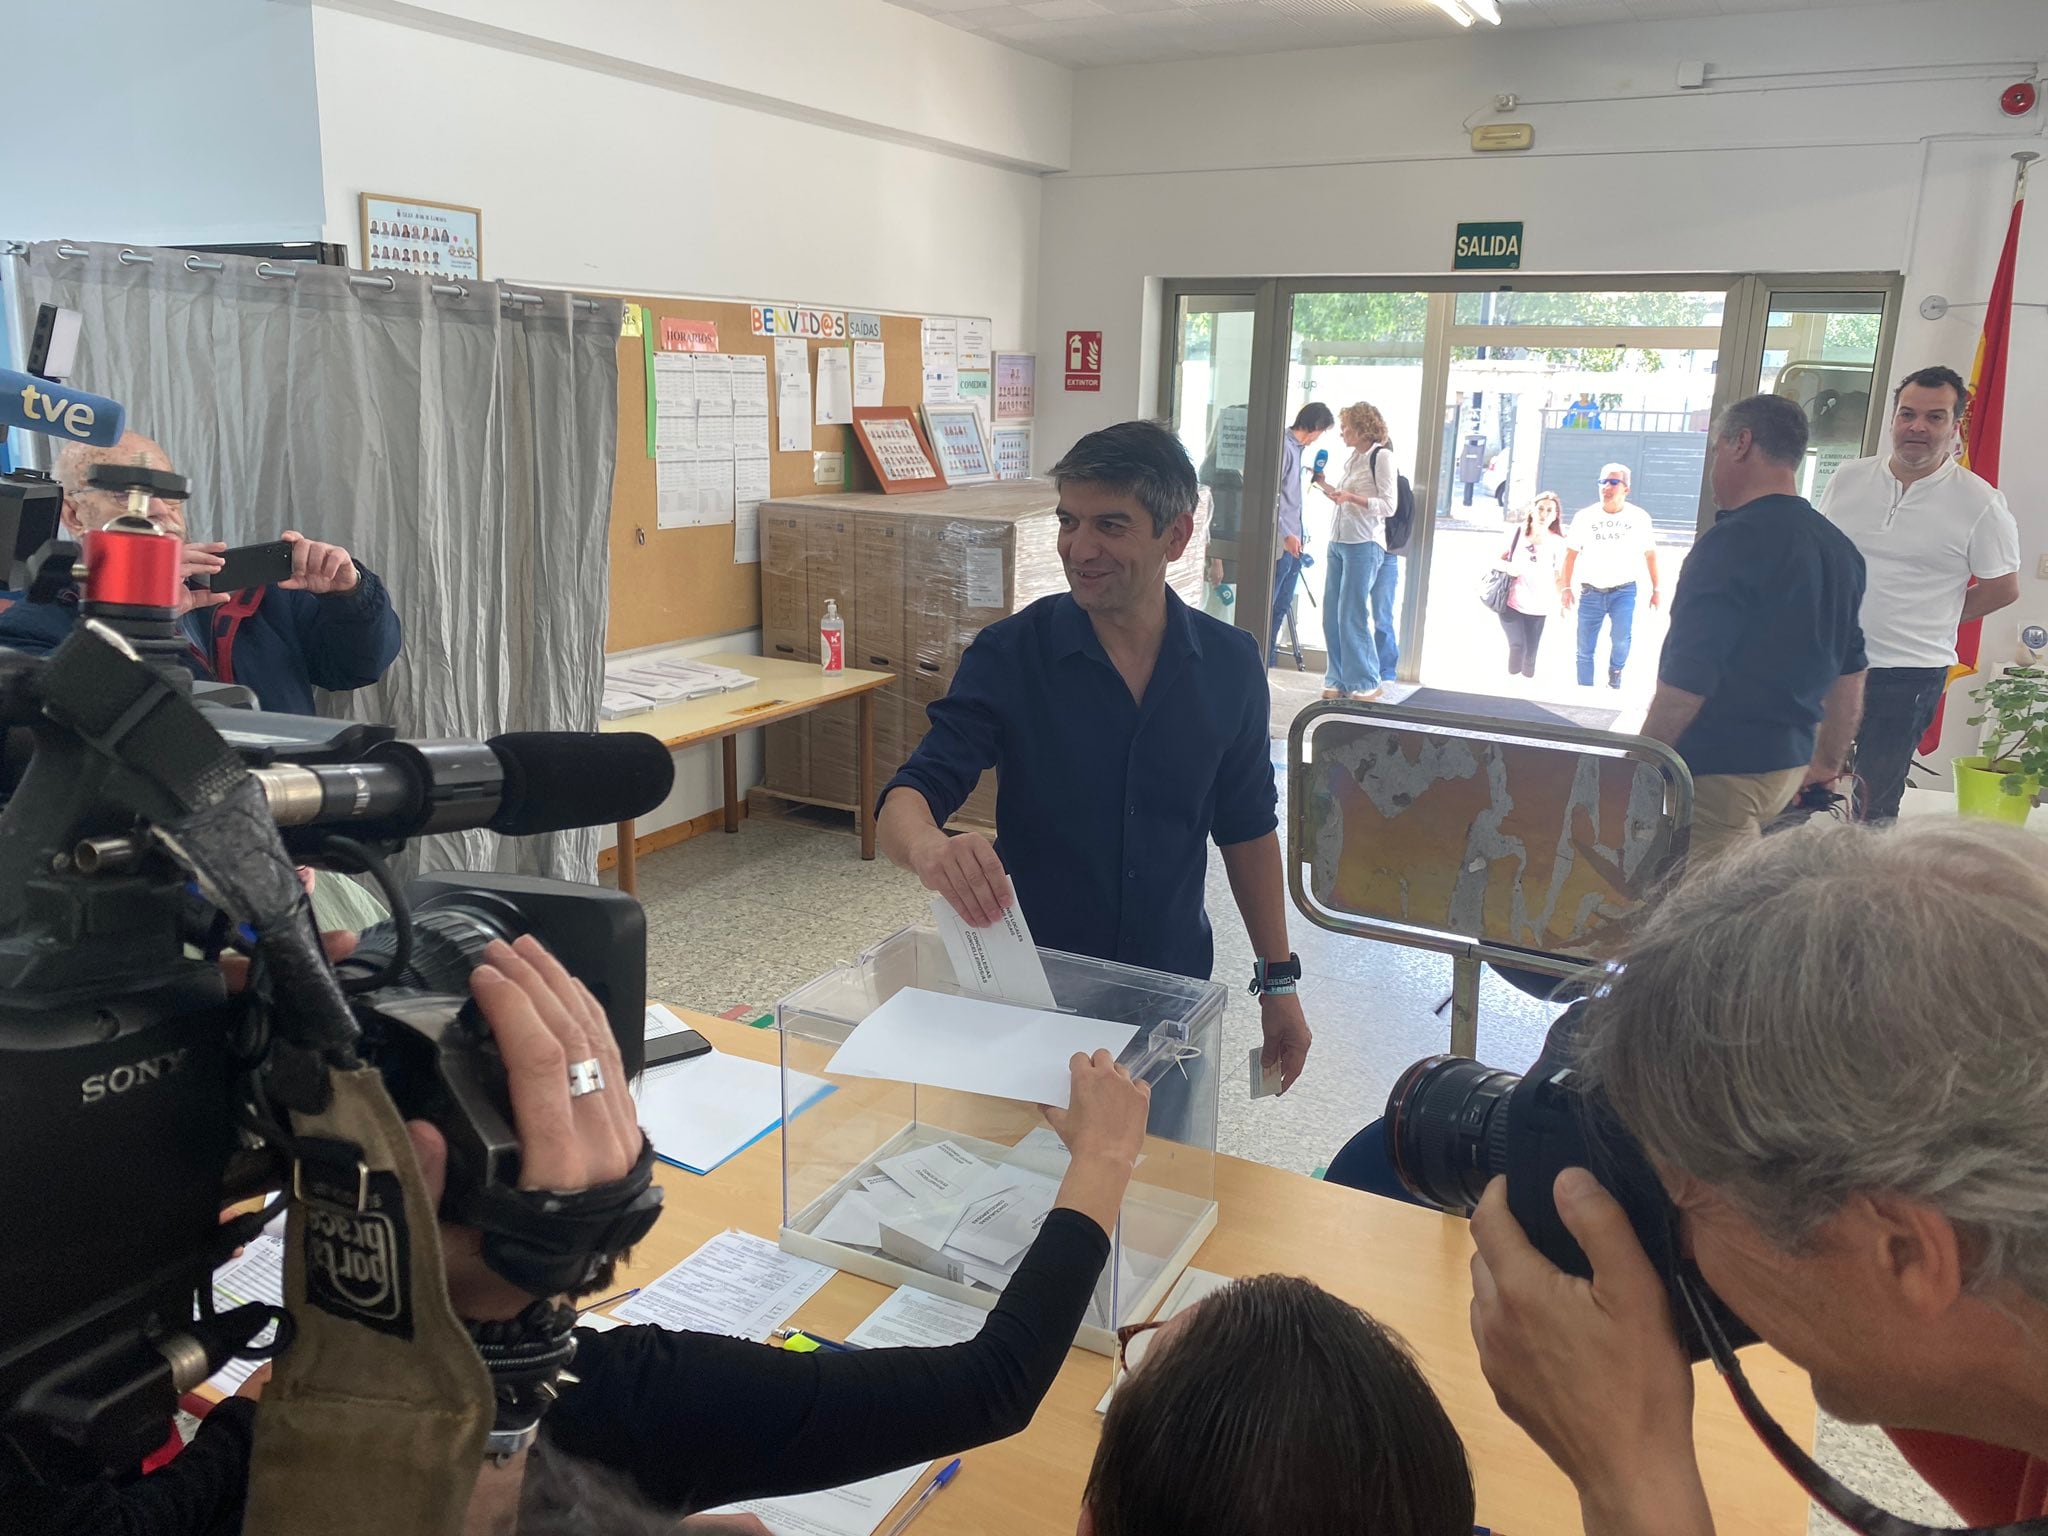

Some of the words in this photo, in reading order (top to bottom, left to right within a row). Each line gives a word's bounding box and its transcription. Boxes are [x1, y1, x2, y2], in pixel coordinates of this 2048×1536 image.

[1457, 235, 1519, 257] SALIDA
[751, 306, 845, 337] BENVID@S
[849, 319, 879, 337] SAÍDAS
[666, 330, 713, 344] HORARIOS
[960, 380, 987, 389] COMEDOR
[1066, 378, 1099, 386] EXTINTOR
[20, 384, 95, 438] tve
[81, 1047, 187, 1105] SONY
